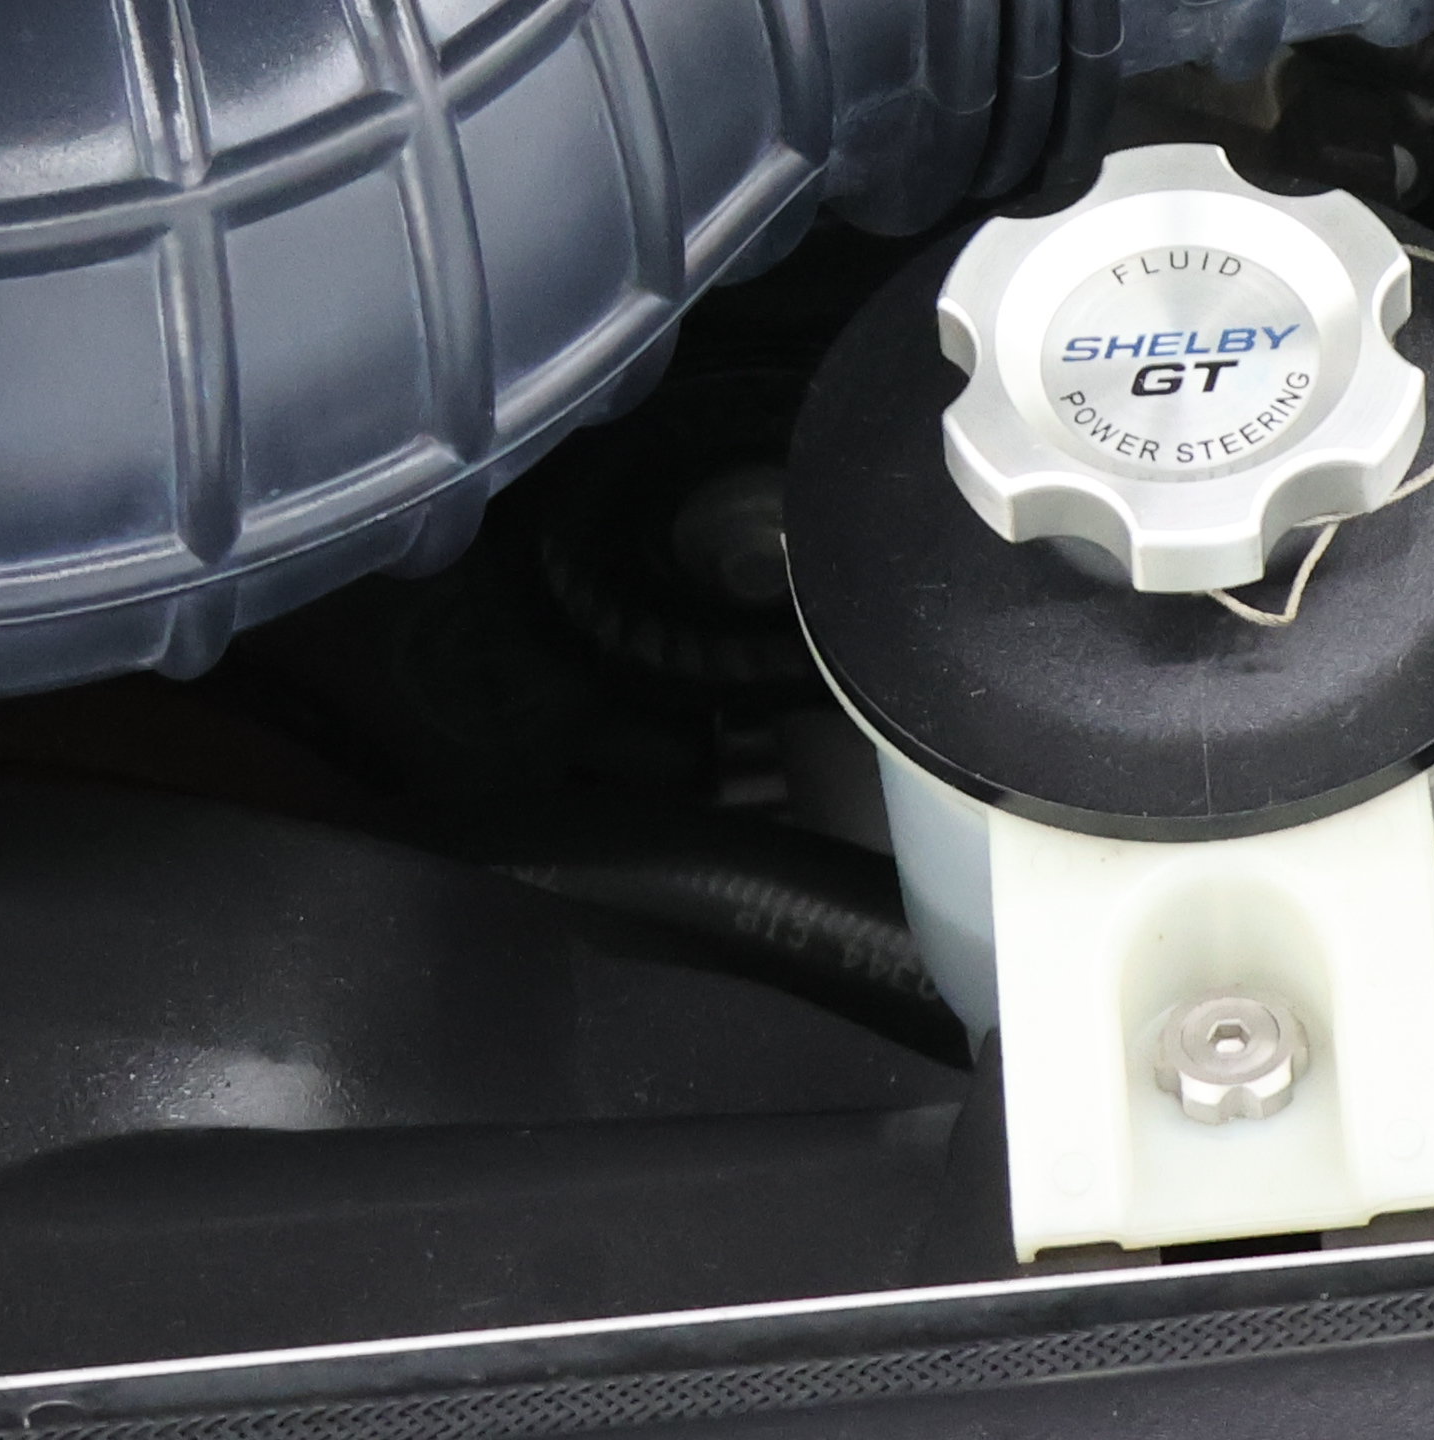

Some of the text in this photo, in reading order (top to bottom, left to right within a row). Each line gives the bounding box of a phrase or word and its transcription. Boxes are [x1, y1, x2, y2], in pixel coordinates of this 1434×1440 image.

[1111, 250, 1243, 285] FLUID
[1061, 323, 1301, 363] SHELBY
[1130, 359, 1241, 397] GT
[1059, 369, 1311, 465] POWER STEERING
